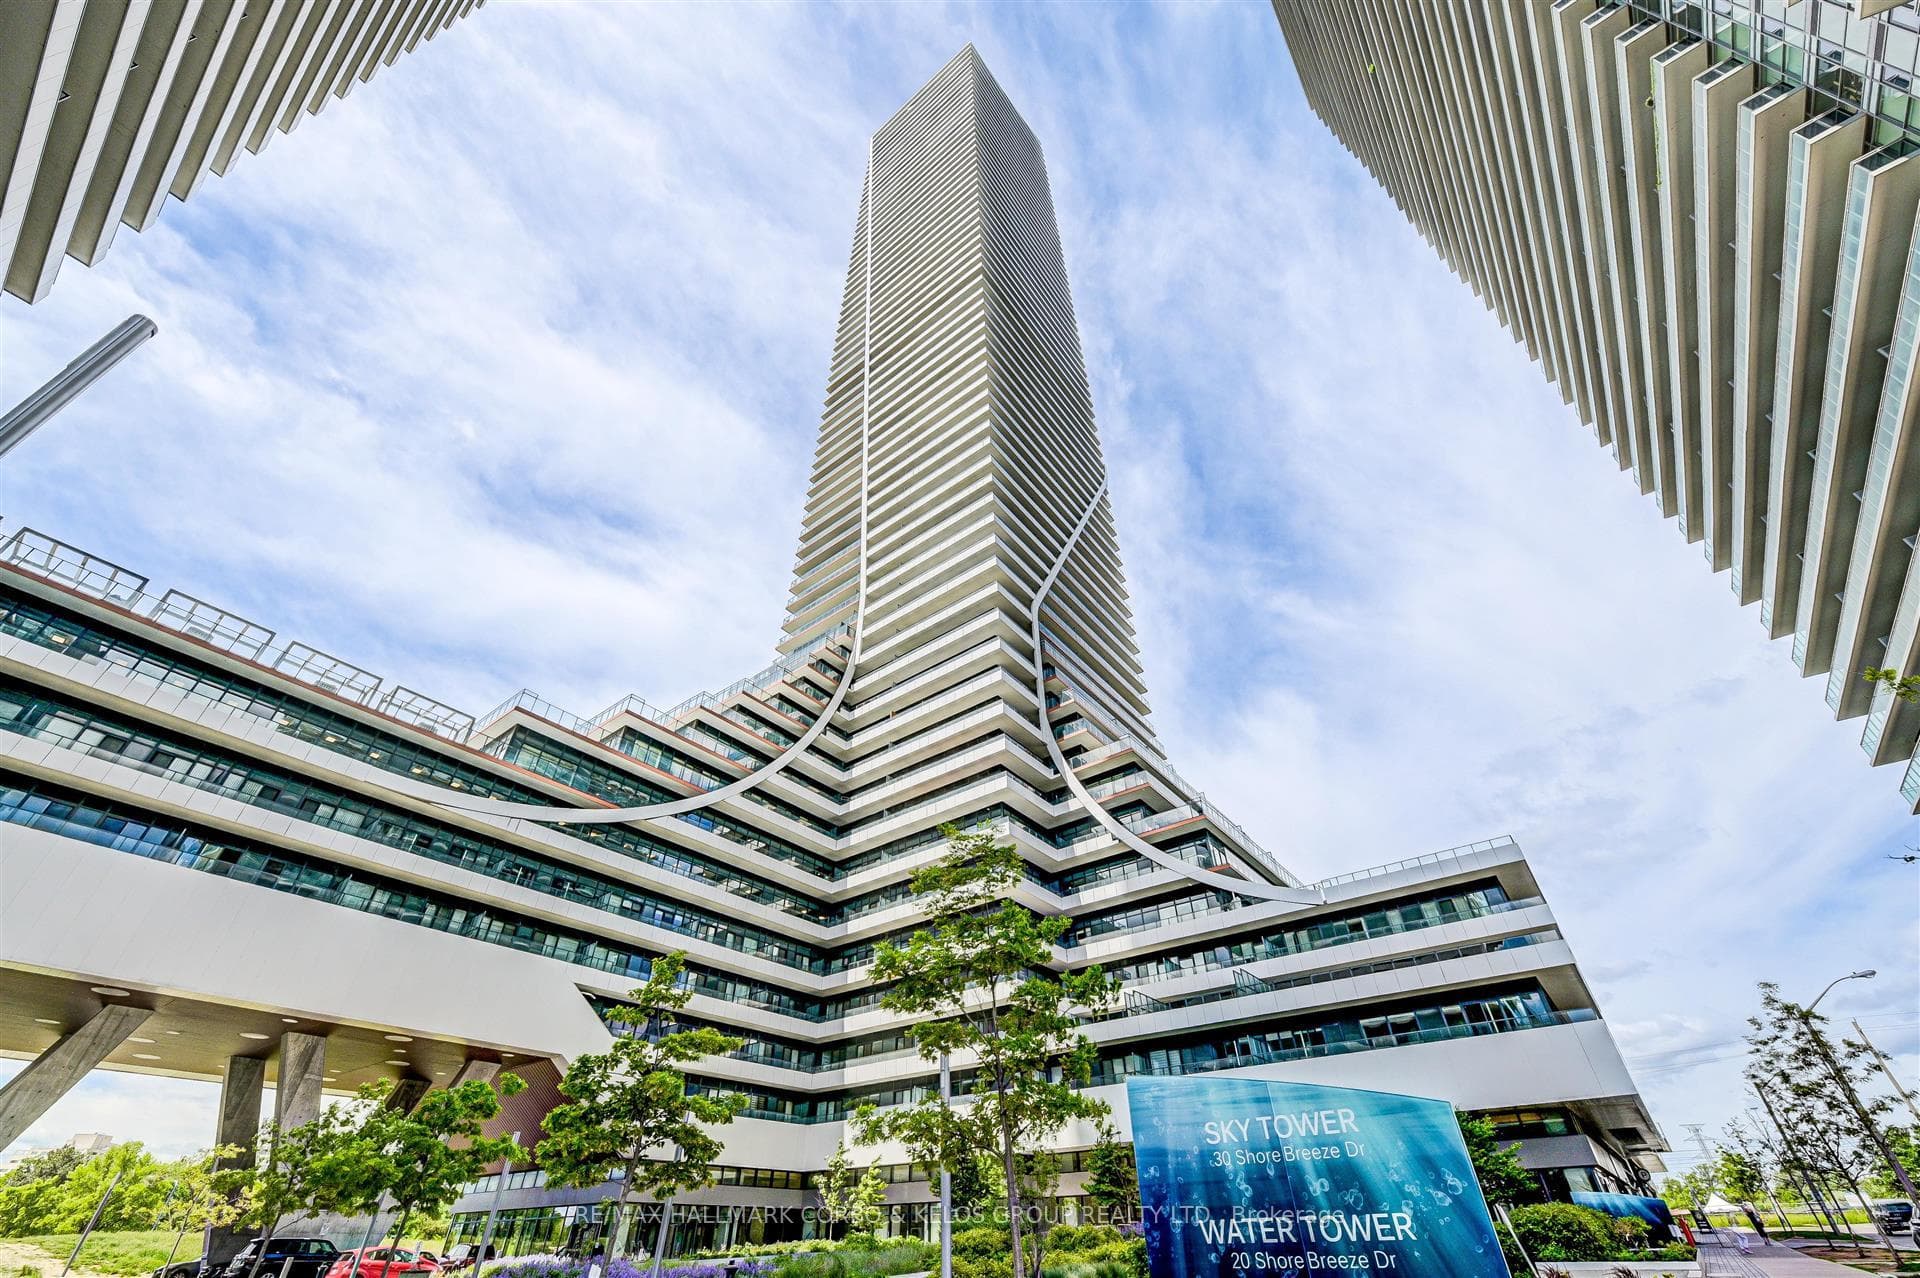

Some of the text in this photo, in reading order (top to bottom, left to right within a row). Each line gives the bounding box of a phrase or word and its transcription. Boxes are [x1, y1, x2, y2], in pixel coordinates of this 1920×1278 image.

[1204, 1108, 1360, 1145] SKY TOWER
[1212, 1141, 1366, 1167] 30 Shore Breeze Dr
[1199, 1212, 1418, 1245] WATER TOWER
[1230, 1250, 1397, 1269] 20 Shore Breeze Dr
